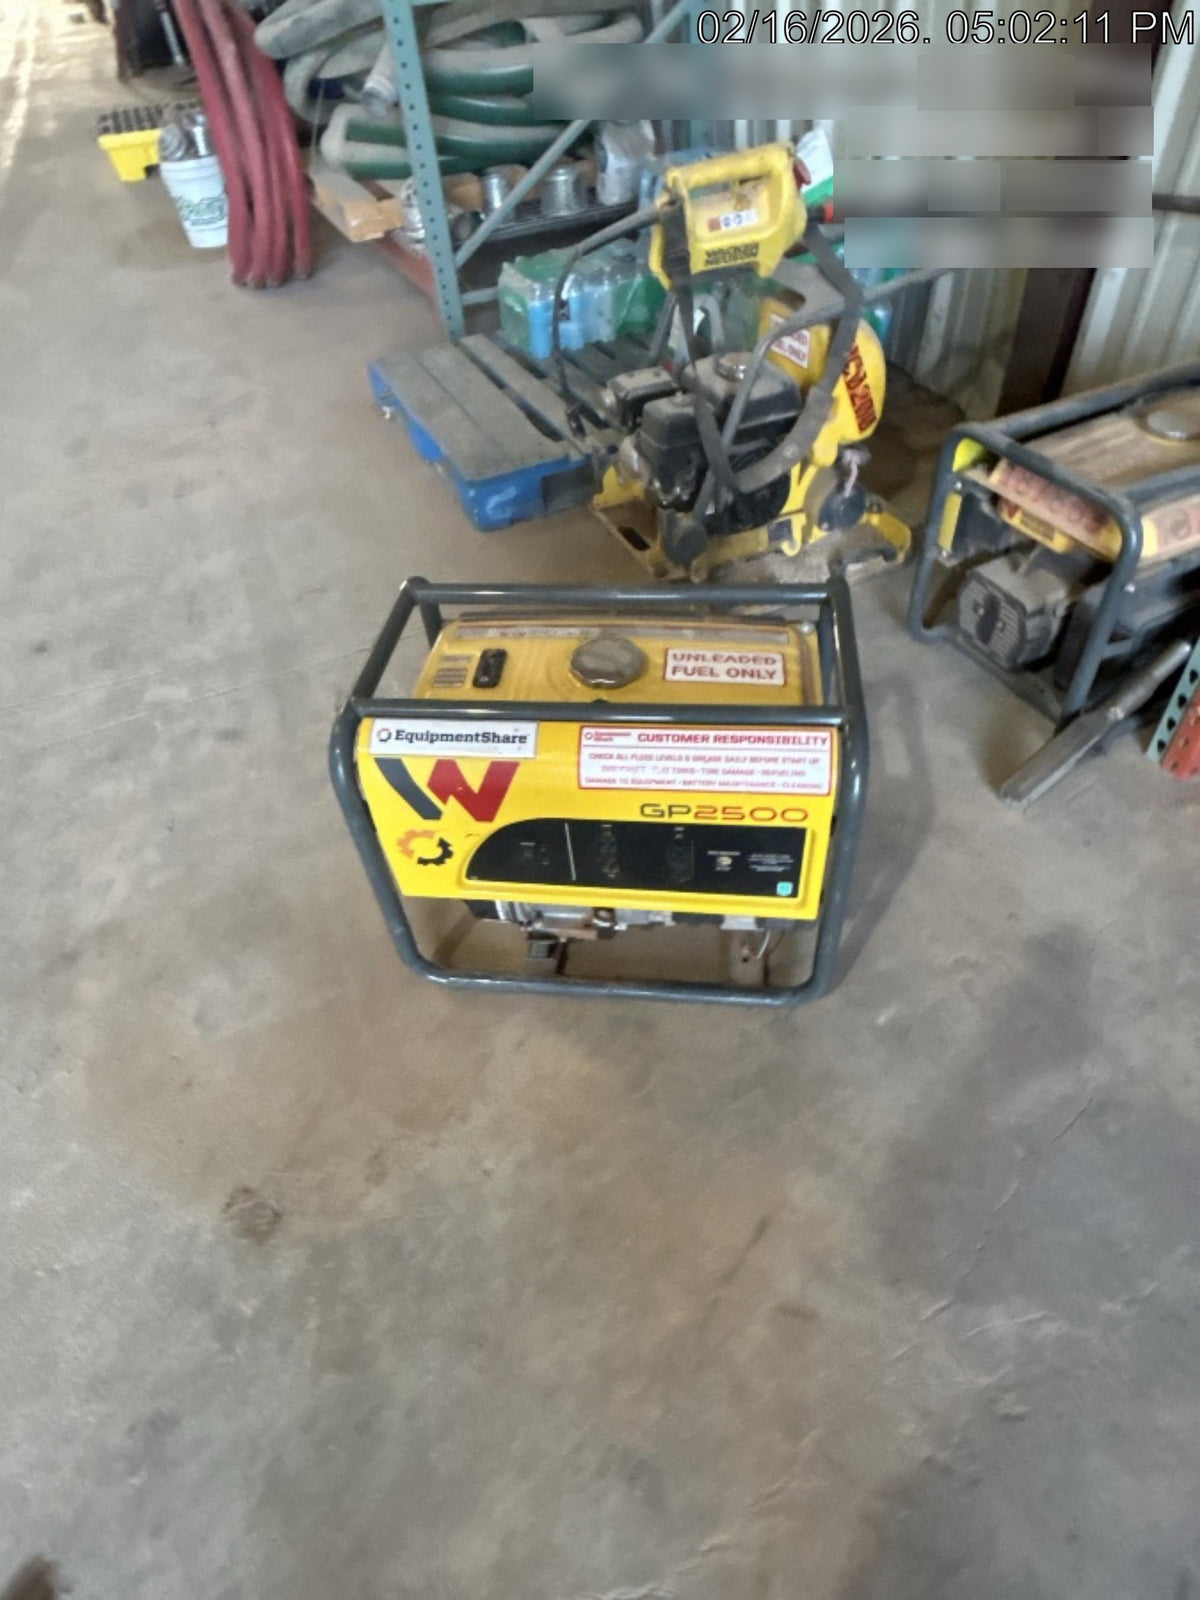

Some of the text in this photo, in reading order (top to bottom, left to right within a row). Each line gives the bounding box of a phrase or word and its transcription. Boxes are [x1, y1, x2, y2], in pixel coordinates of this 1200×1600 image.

[672, 652, 776, 665] UNLEADED
[671, 665, 777, 680] FUEL ONLY
[394, 729, 528, 744] EquipmentShare
[637, 732, 710, 744] CUSTOMER
[713, 733, 828, 747] RESPONSIBILITY
[640, 802, 809, 824] GP2500
